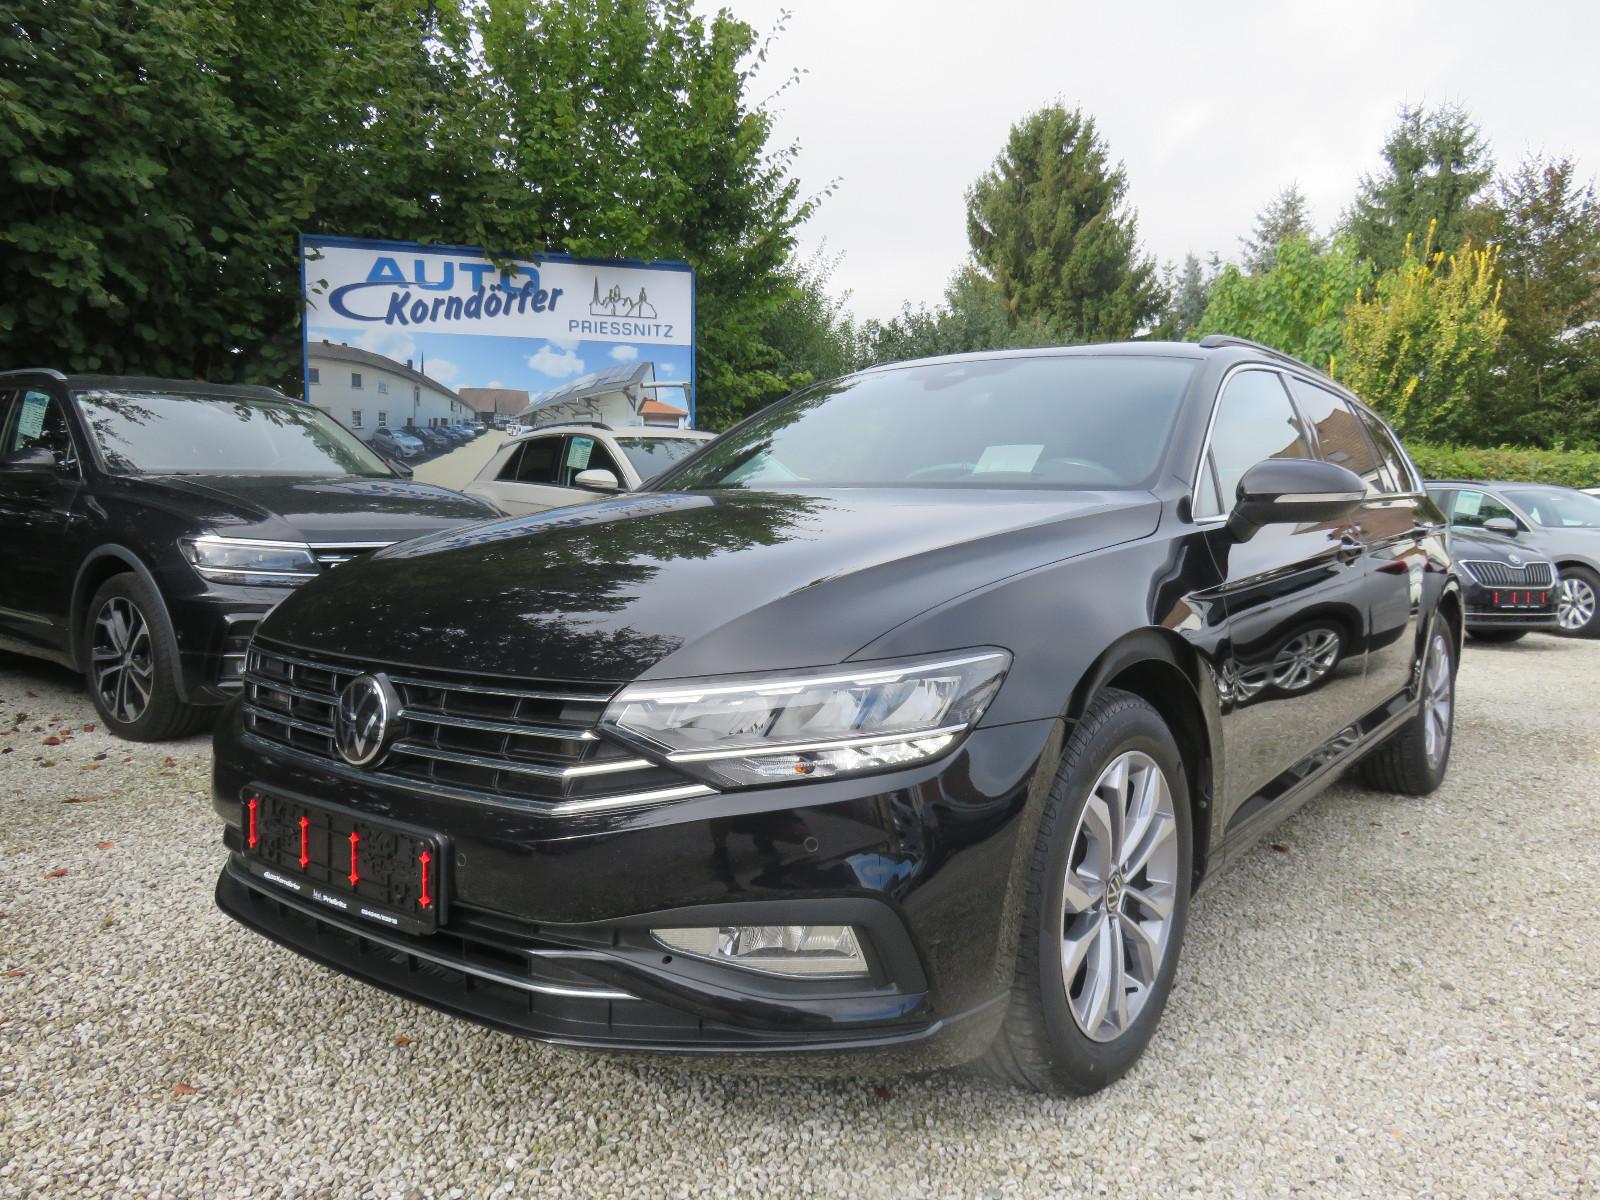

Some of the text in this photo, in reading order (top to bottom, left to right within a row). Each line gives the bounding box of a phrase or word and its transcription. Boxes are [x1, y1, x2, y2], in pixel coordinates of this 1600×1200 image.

[366, 257, 541, 293] AUTO
[384, 280, 564, 326] Korndörfer
[568, 319, 674, 338] PRIESSNITZ
